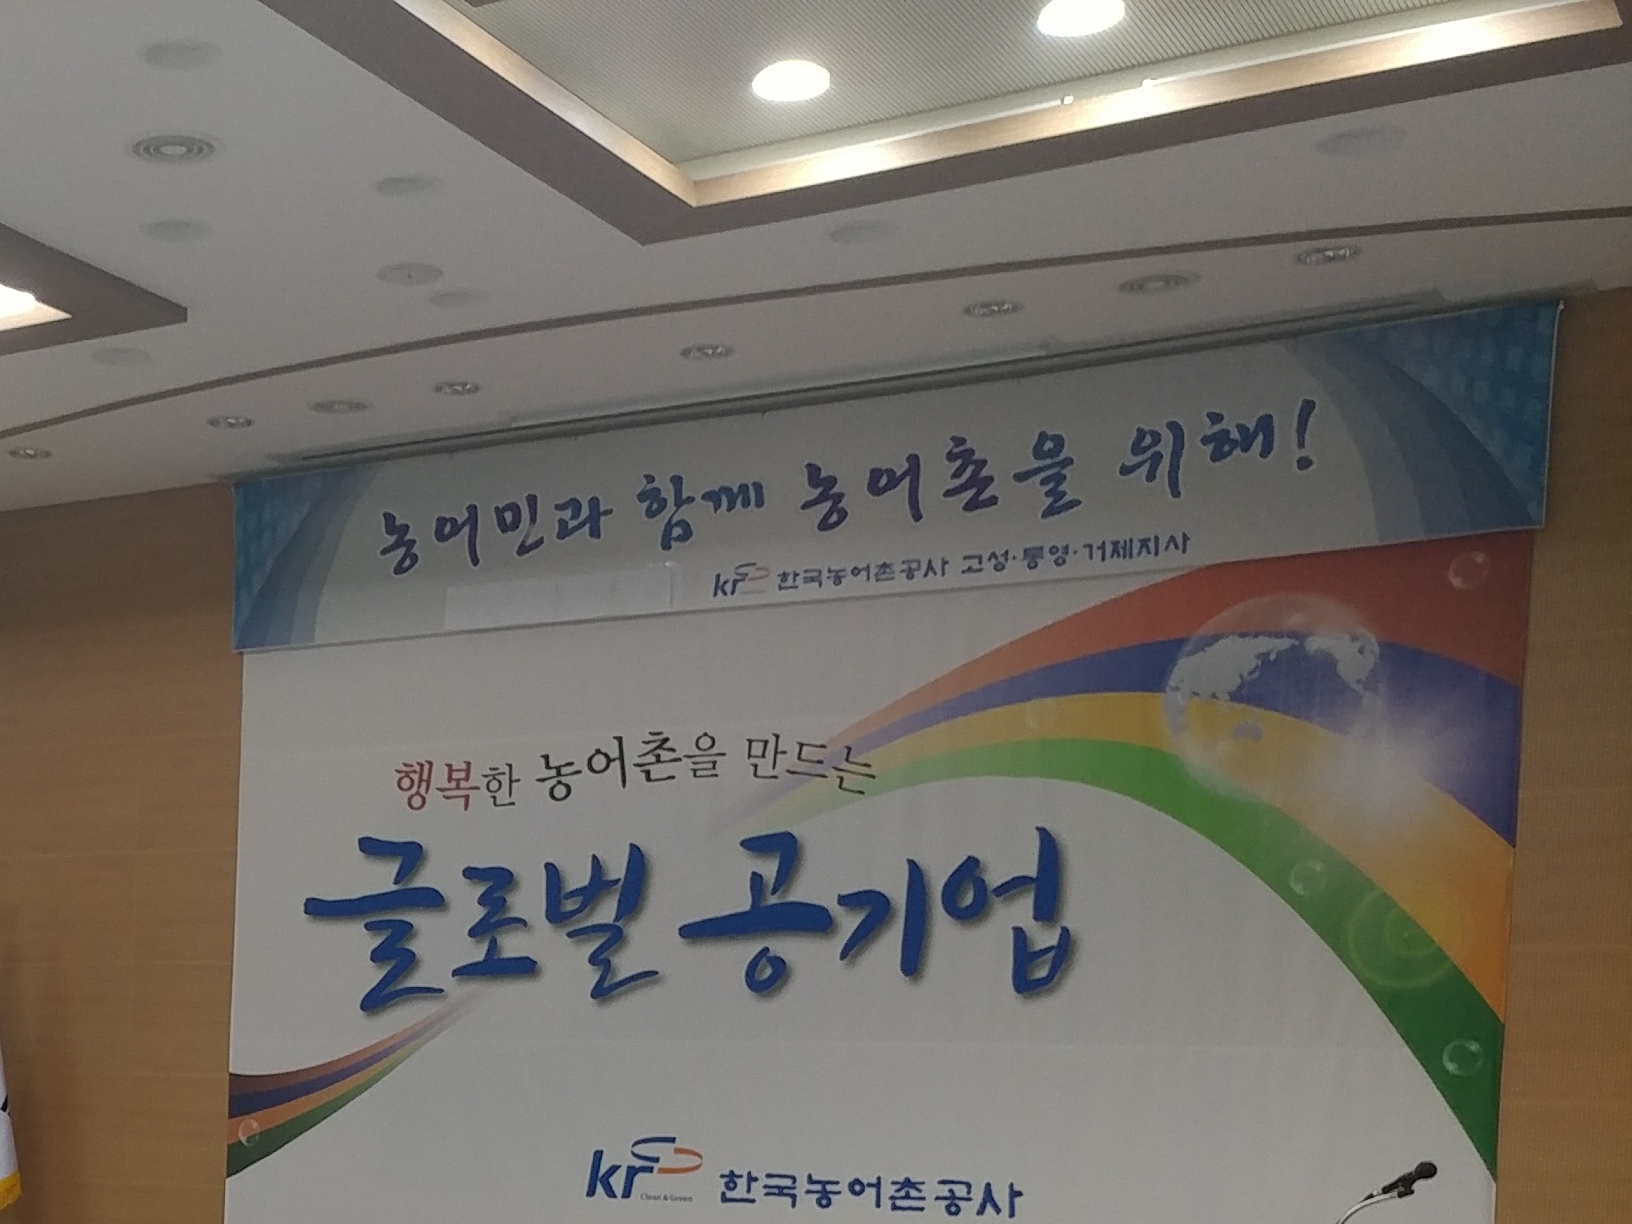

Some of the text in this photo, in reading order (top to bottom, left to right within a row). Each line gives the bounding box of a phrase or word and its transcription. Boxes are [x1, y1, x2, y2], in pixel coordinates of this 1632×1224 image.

[380, 398, 1317, 576] 농어민과 함께 농어촌을 위해!
[776, 557, 949, 591] 한국농어촌공사
[395, 730, 878, 812] 행복한 농어촌을 만드는
[302, 825, 1077, 1015] 글로벌 공기업
[719, 1170, 1025, 1220] 한국농어촌공사
